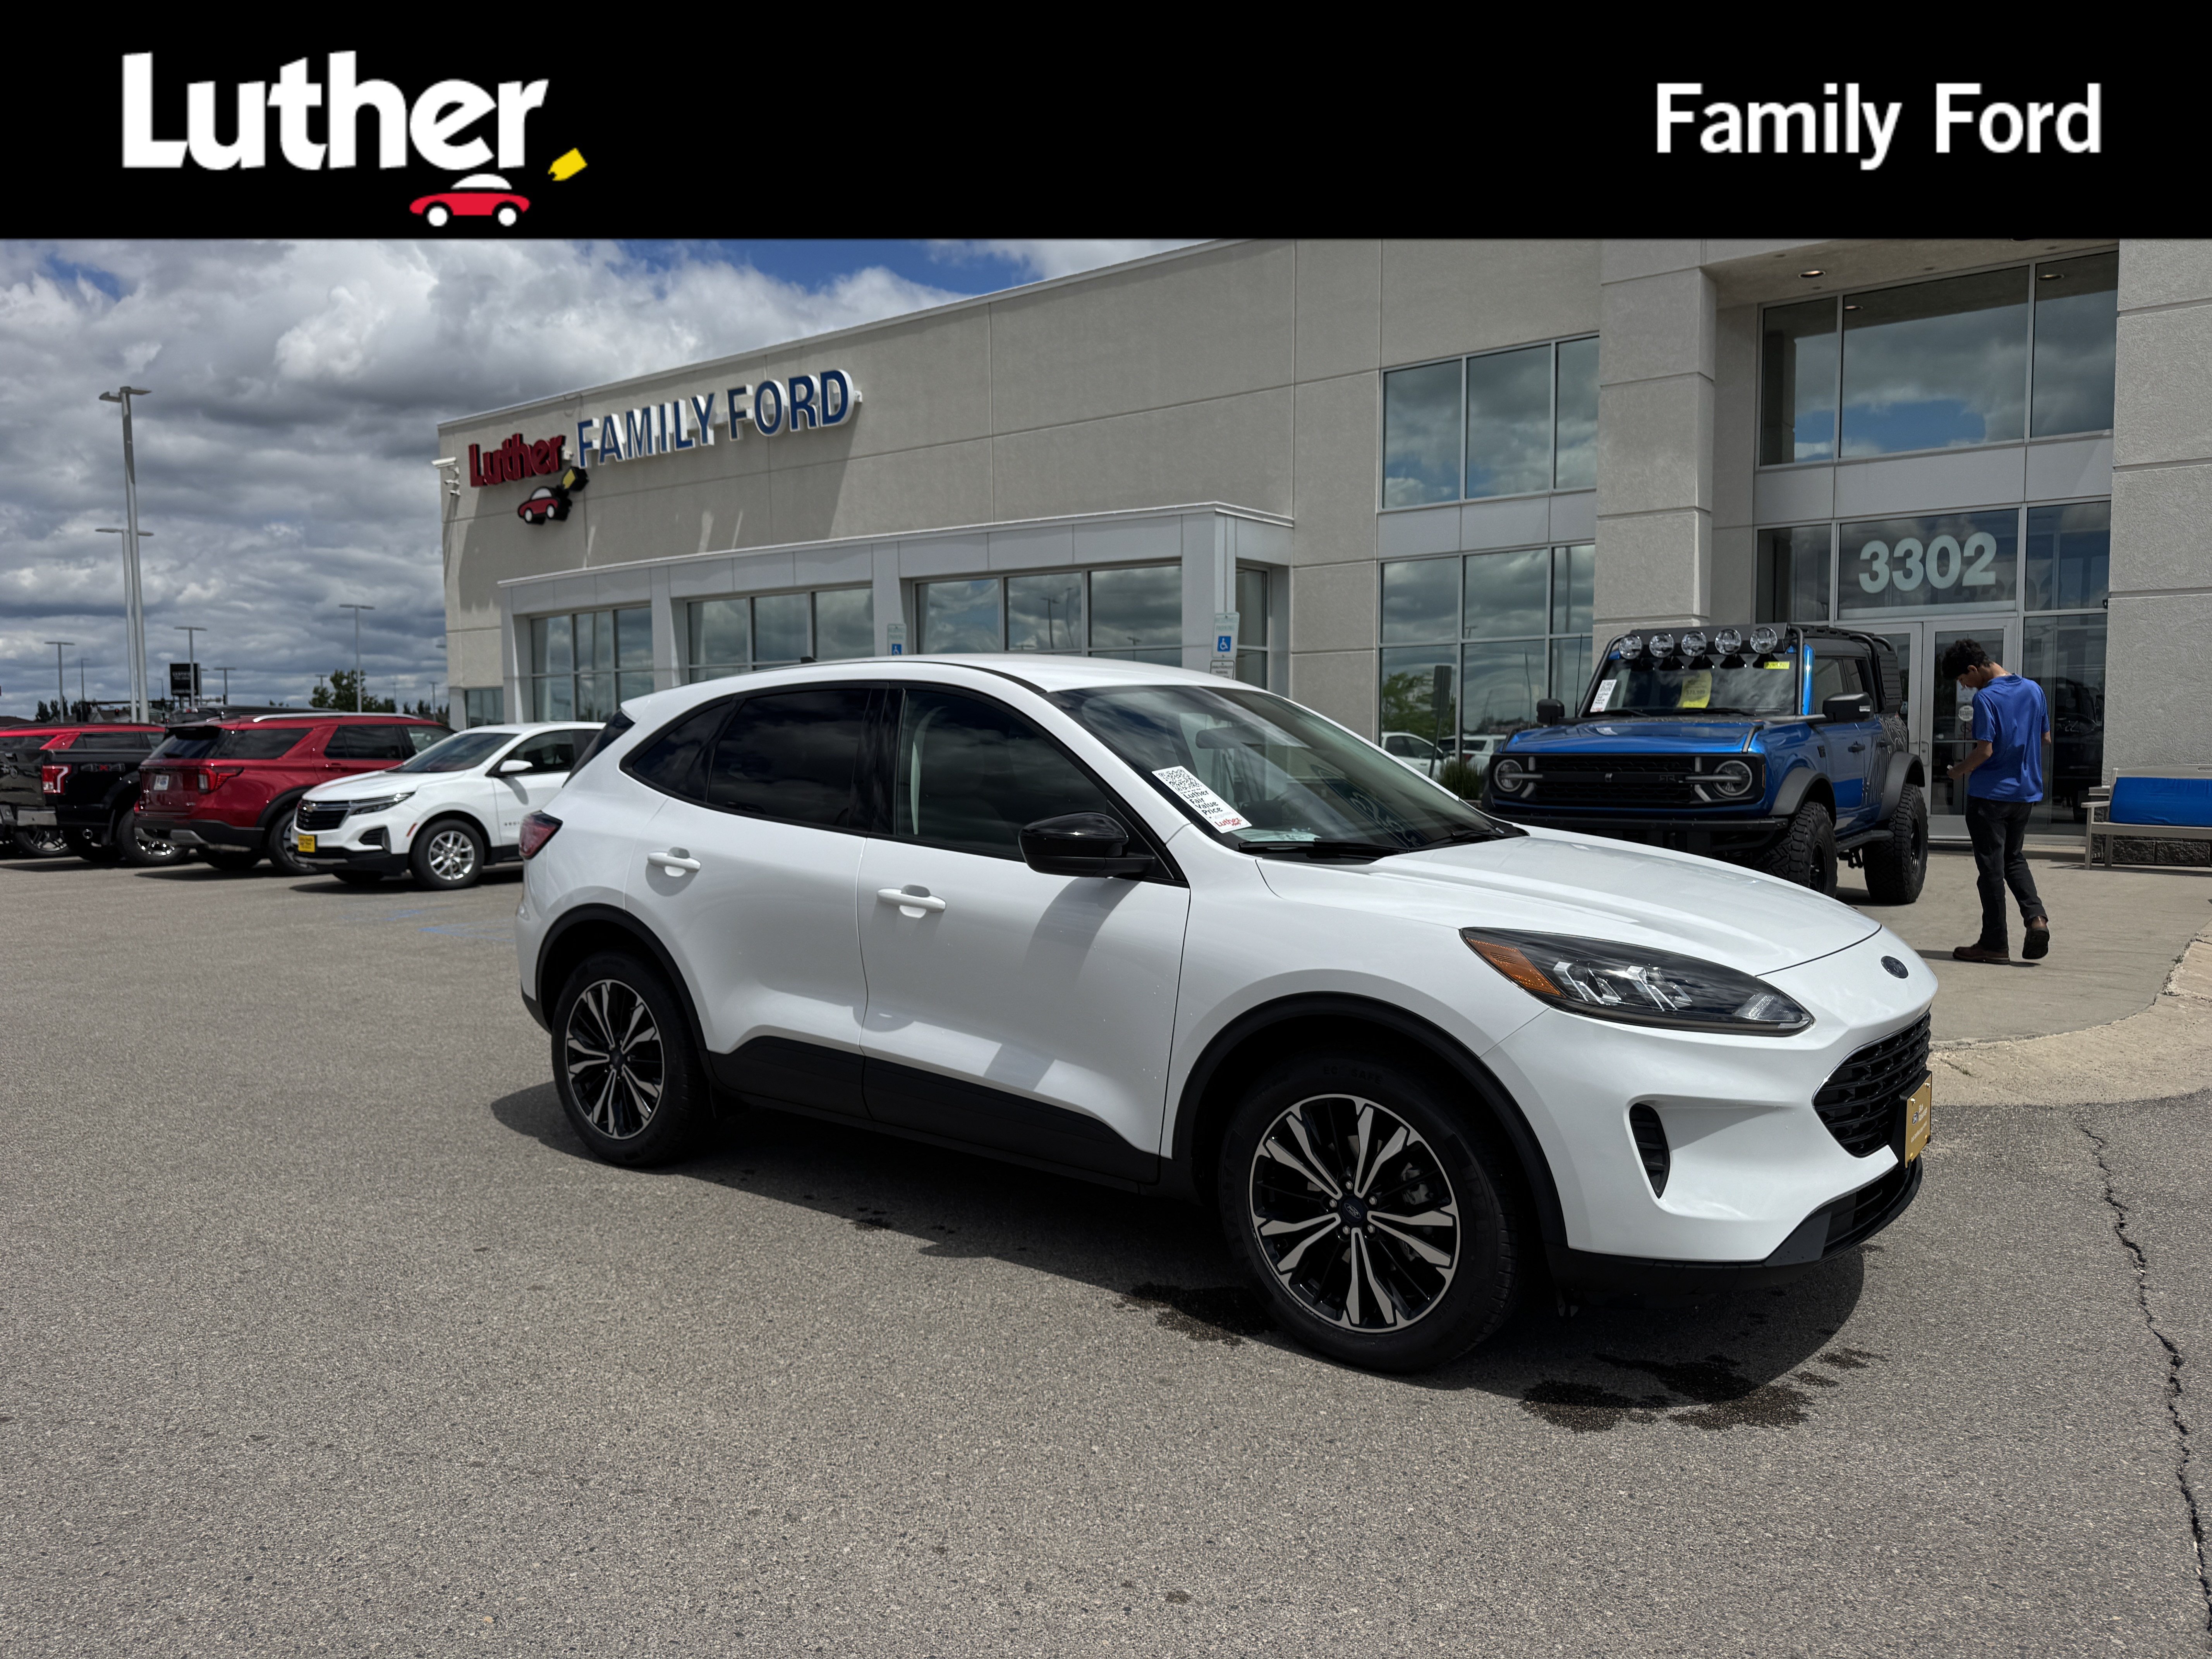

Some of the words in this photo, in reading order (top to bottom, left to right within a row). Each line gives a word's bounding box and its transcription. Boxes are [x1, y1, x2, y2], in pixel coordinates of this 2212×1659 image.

[576, 393, 716, 469] FAMILY
[726, 368, 854, 441] FORD
[468, 433, 567, 488] Luther
[1858, 531, 1997, 594] 3302
[1183, 790, 1209, 799] Luther
[1195, 801, 1219, 809] Value
[1201, 807, 1223, 816] Price
